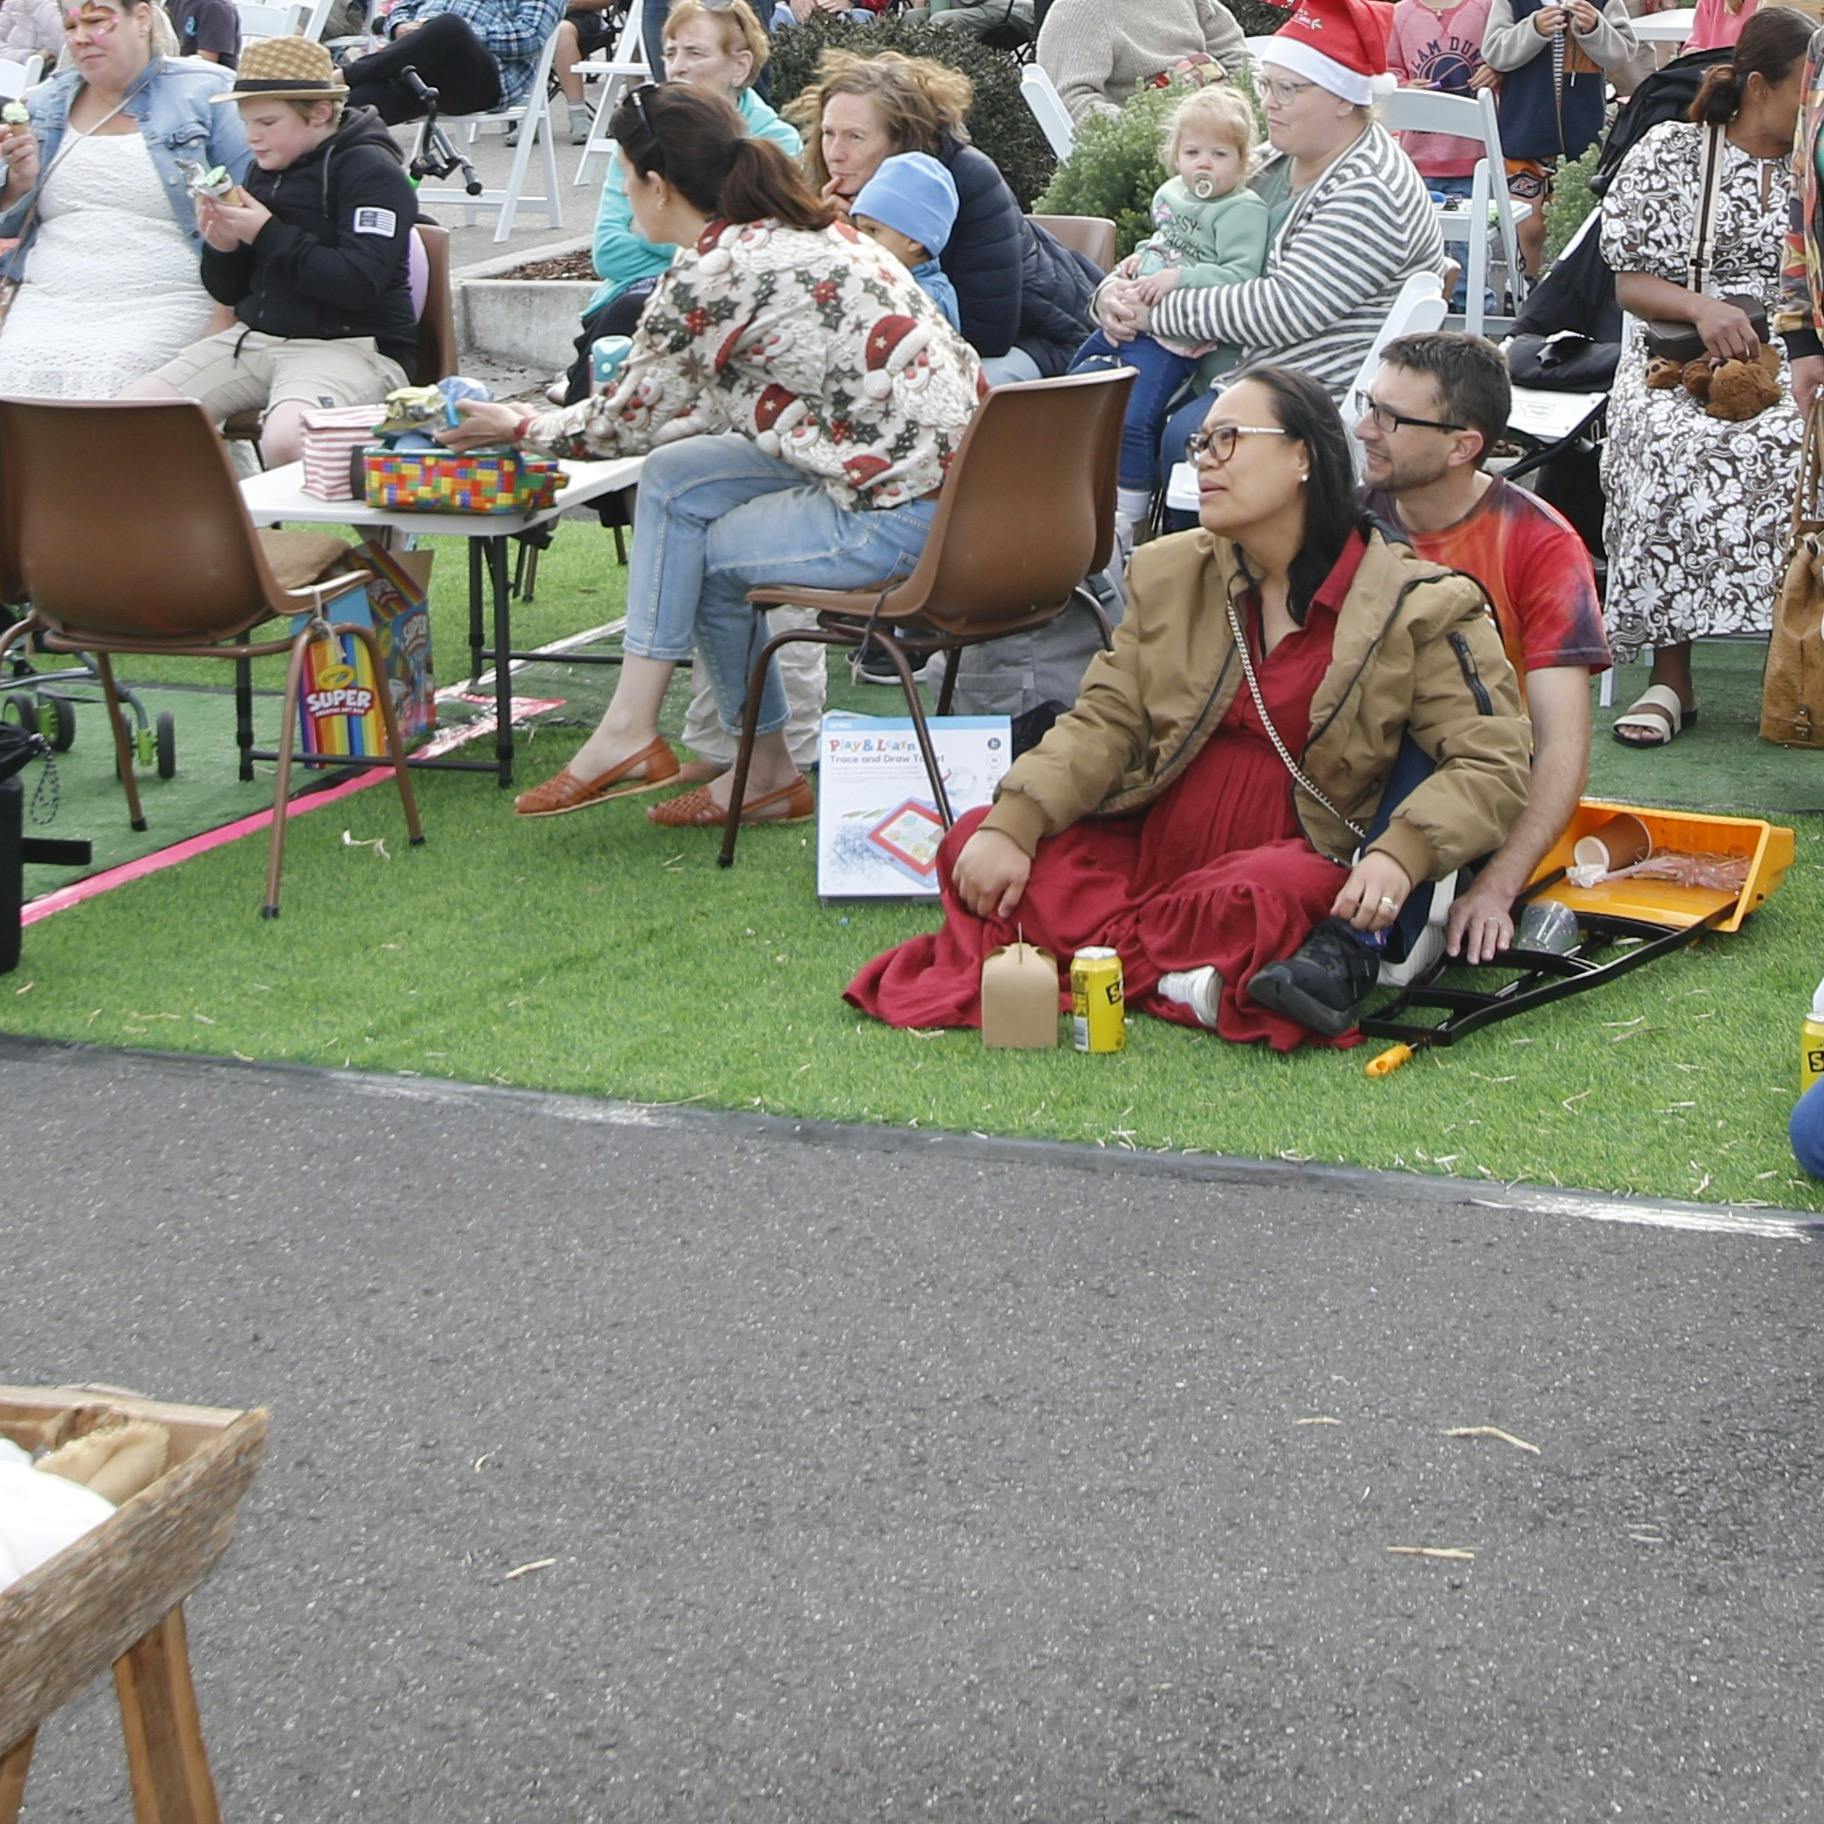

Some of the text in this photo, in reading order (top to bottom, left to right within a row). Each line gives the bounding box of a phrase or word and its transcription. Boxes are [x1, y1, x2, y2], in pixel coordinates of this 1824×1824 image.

[306, 688, 372, 713] SUPER
[830, 755, 859, 764] Trace
[862, 754, 881, 764] and
[883, 754, 911, 764] Draw
